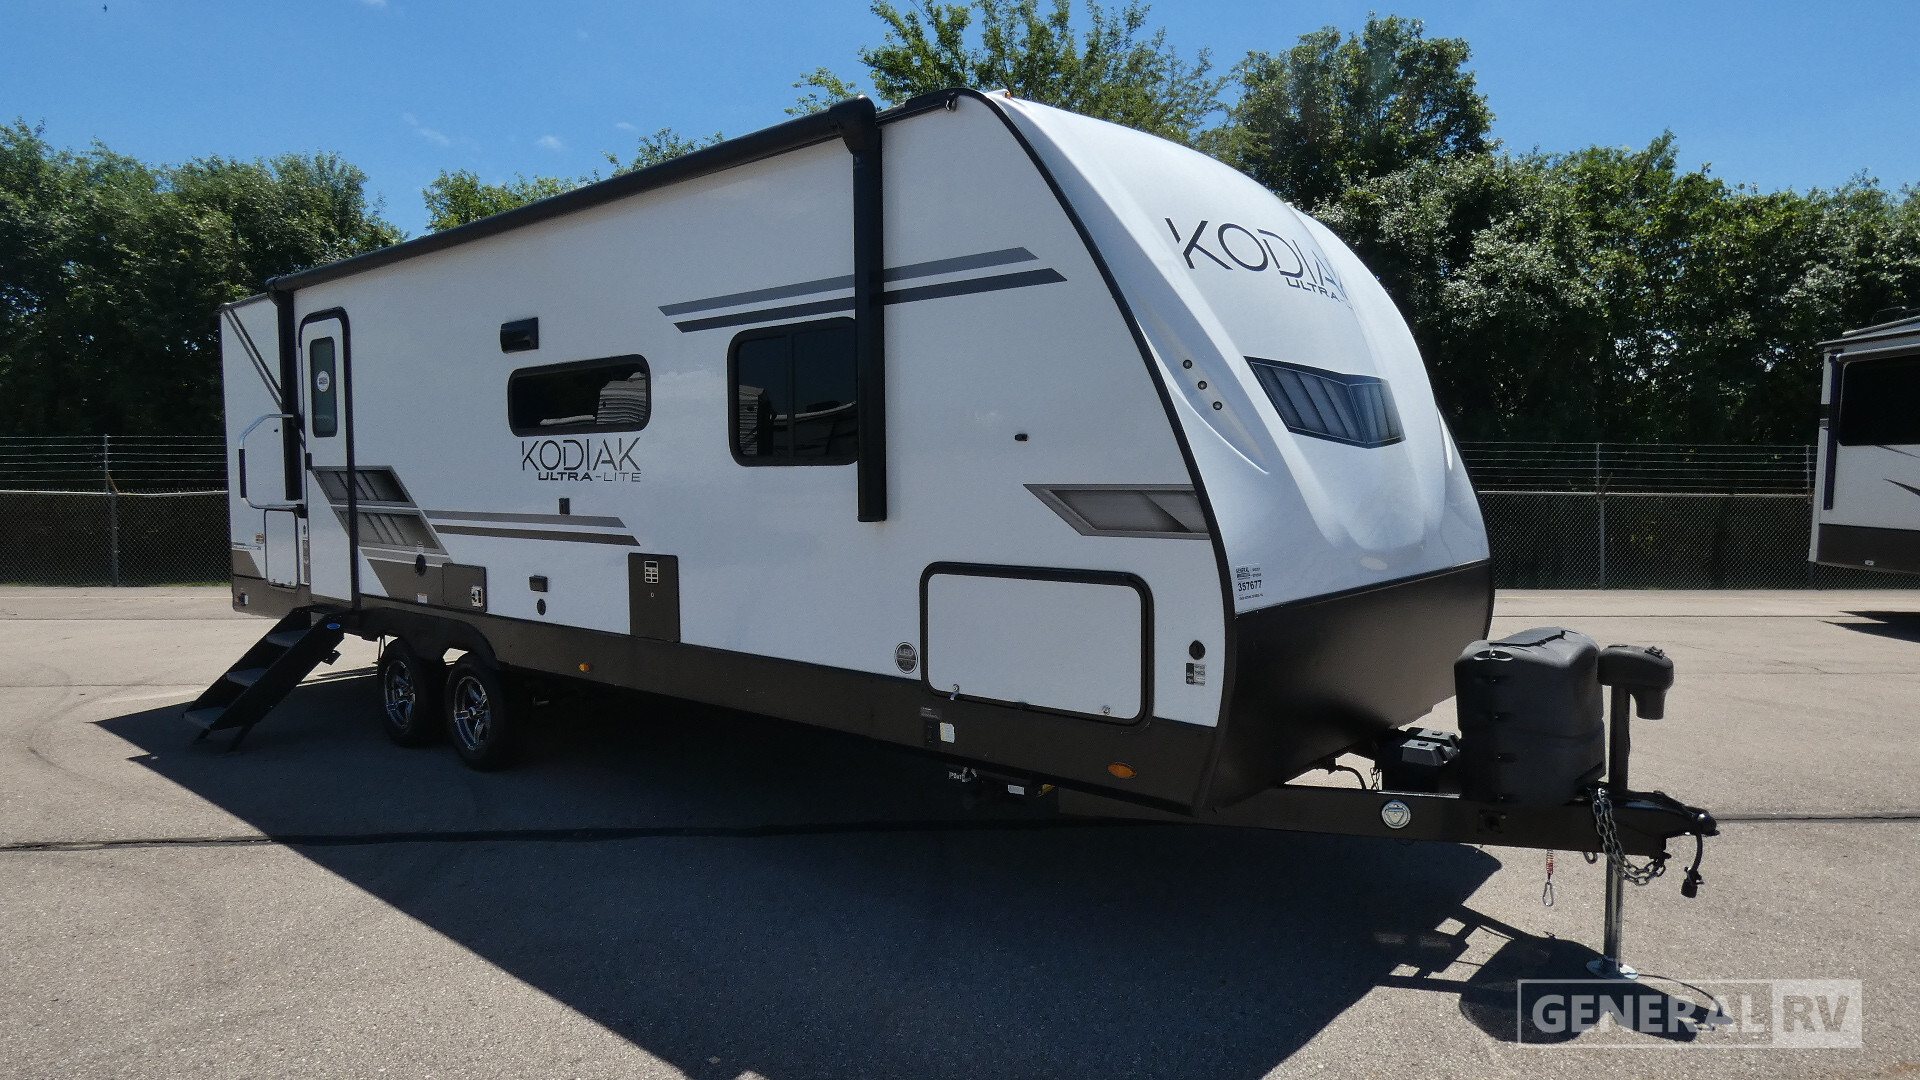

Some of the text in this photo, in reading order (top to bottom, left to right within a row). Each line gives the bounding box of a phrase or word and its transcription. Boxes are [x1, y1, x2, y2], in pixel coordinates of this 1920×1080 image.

[1286, 277, 1351, 308] ULTRA-
[521, 437, 640, 471] KODIAK
[538, 472, 641, 482] ULTRA-LITE
[1238, 580, 1262, 592] 357677
